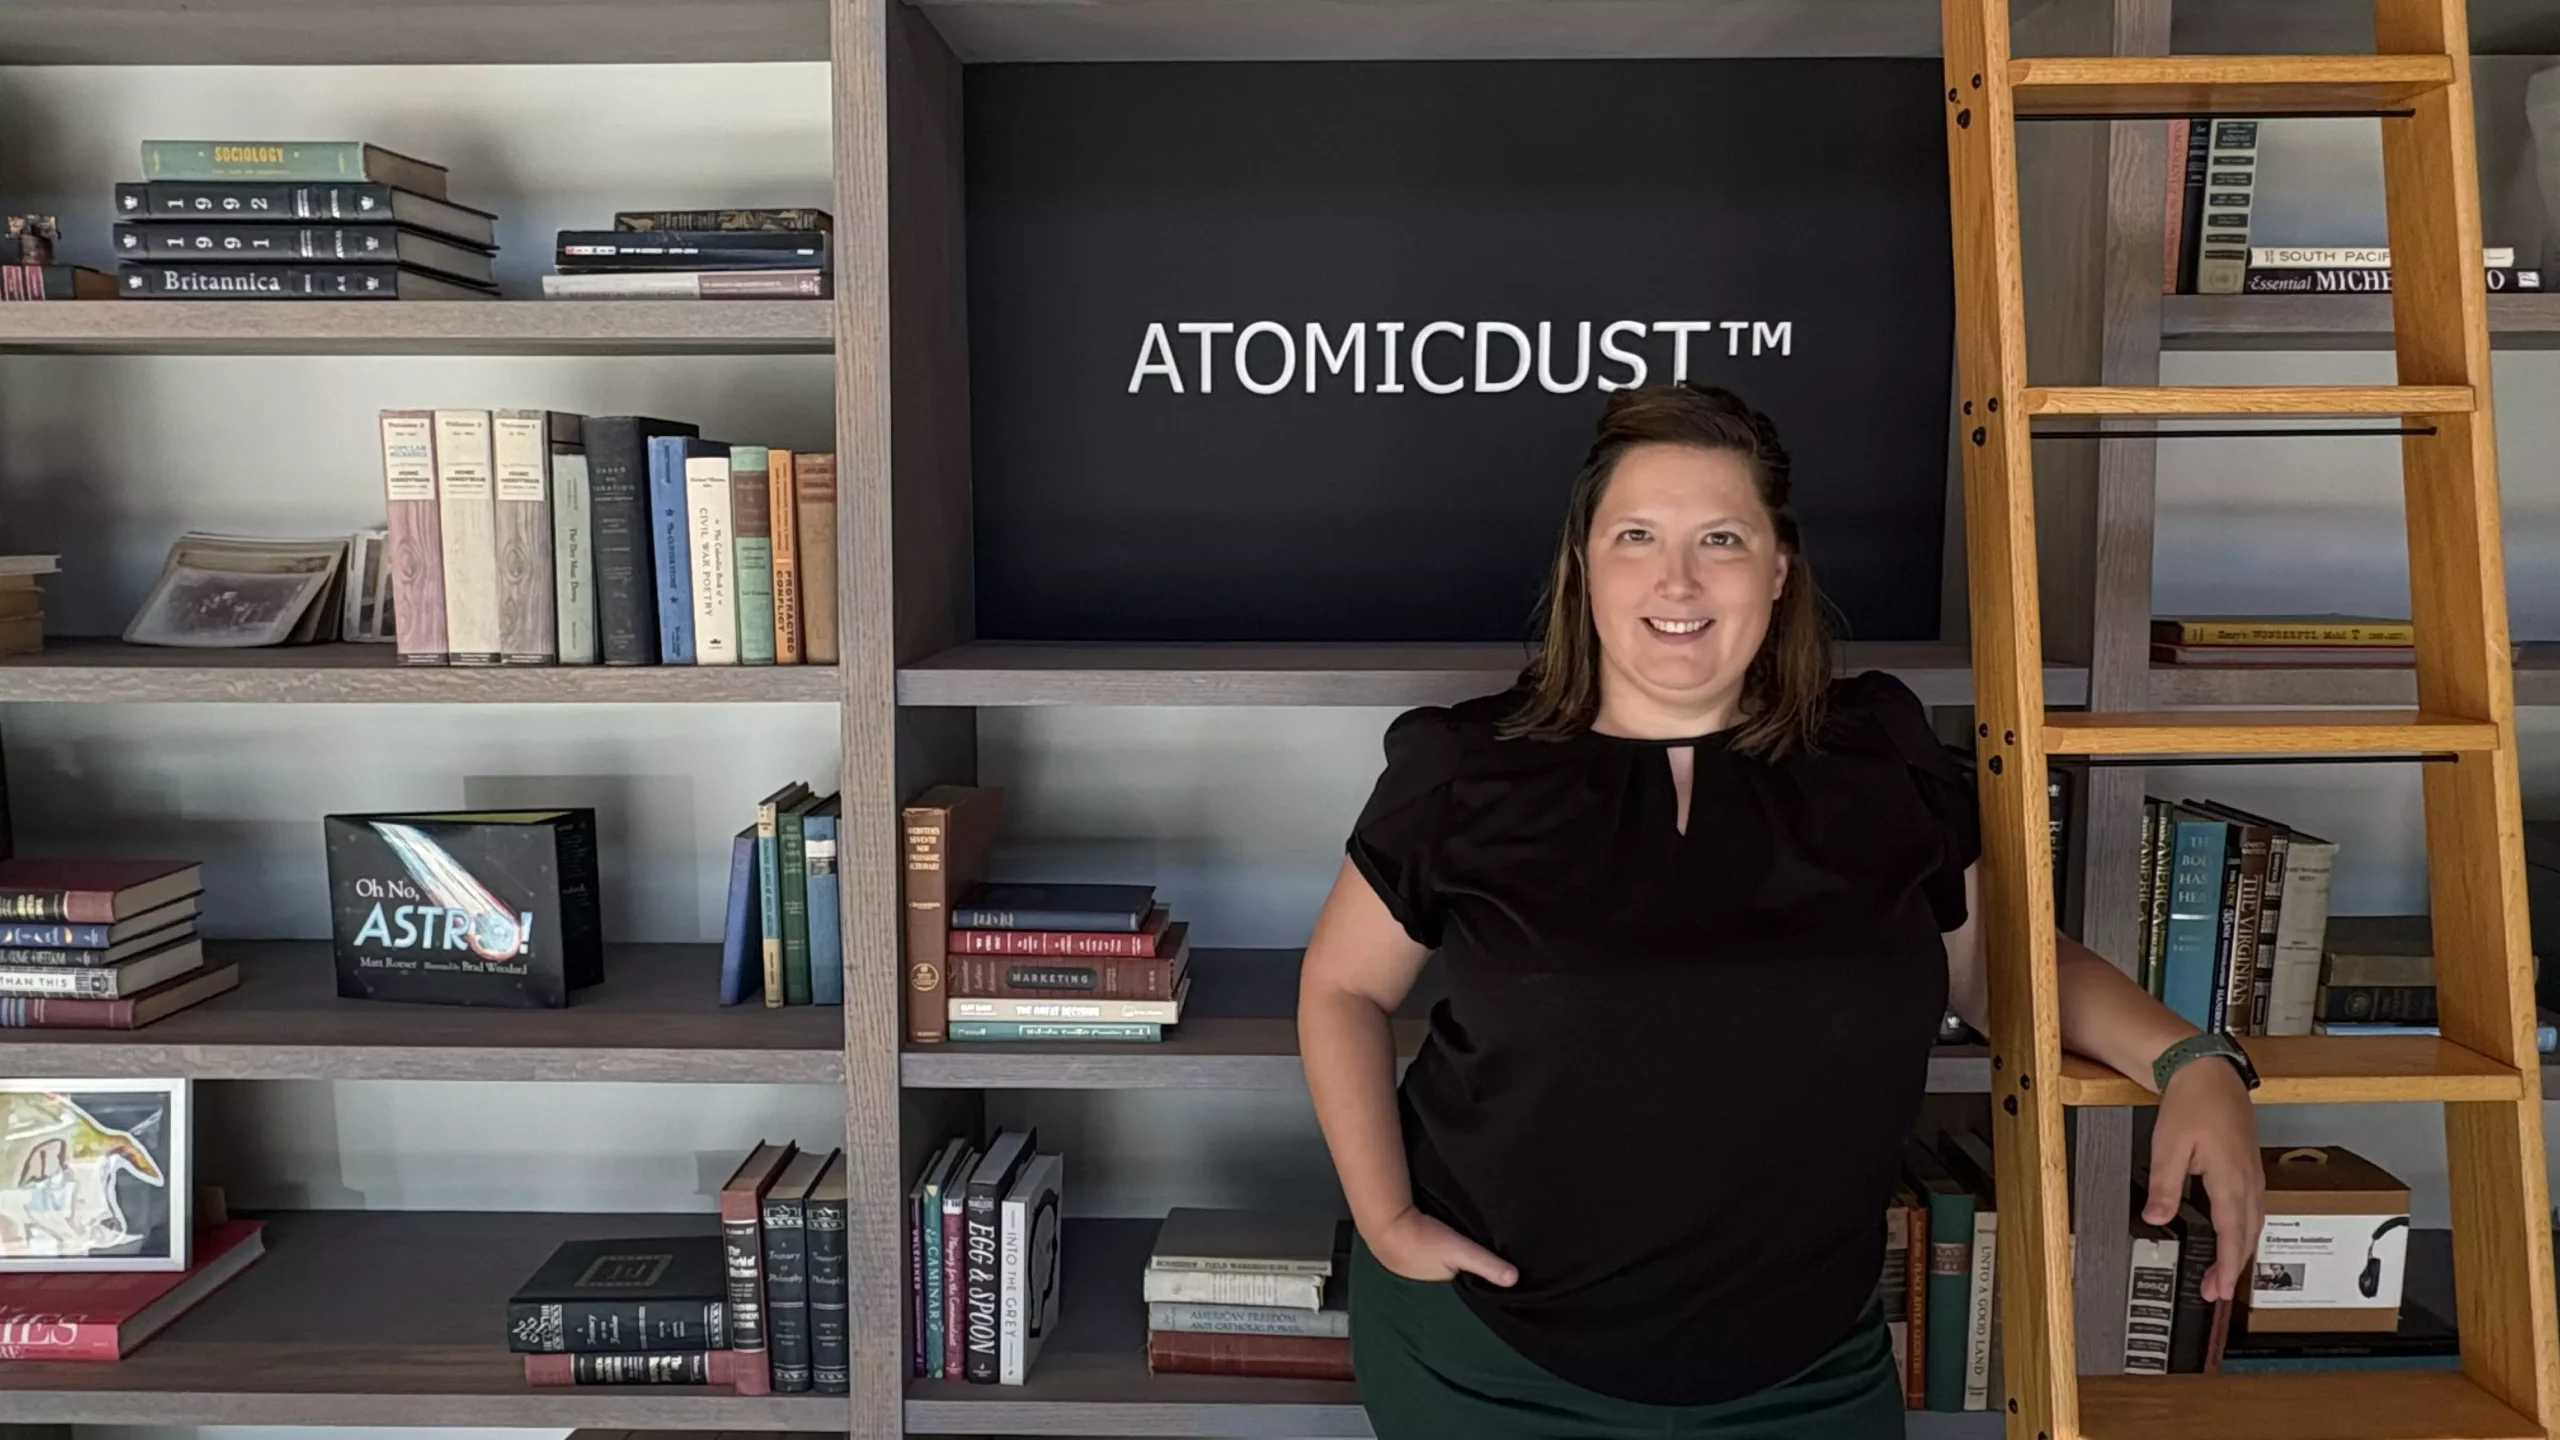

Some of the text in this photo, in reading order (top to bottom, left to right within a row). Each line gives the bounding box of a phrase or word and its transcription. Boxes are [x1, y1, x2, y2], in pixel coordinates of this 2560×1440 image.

[214, 146, 284, 162] SOCIOLOGY
[2279, 251, 2336, 262] SOUTH
[164, 270, 281, 291] Britannica
[2250, 273, 2312, 291] Essential
[698, 507, 713, 617] CIVIL WAR POETRY
[776, 570, 785, 632] CONFLICT
[785, 570, 795, 653] PROTRACTED
[2252, 629, 2319, 640] WONDERFUL
[2351, 629, 2360, 641] T
[916, 844, 930, 853] NEW
[356, 878, 420, 902] Oh No,
[2152, 841, 2170, 925] AMERICA
[2179, 873, 2209, 886] HAS
[2225, 883, 2236, 905] NEW
[2232, 876, 2258, 1005] THE VIRGINIAN
[462, 960, 484, 972] Brad
[0, 977, 68, 988] THAN THIS
[1012, 973, 1090, 984] MARKETING
[1016, 1006, 1033, 1017] THE
[1034, 1006, 1060, 1017] GREAT
[728, 1245, 741, 1257] The
[912, 1229, 921, 1290] UNLEASHED
[767, 1273, 804, 1283] Philosophy
[926, 1246, 942, 1319] CAMINAR
[968, 1220, 996, 1355] EGG & SPOON
[1004, 1232, 1018, 1338] INTO THE GREY
[1190, 1310, 1297, 1322] AMERICAN FREEDOM
[1912, 1295, 1922, 1327] RIVER
[1974, 1245, 1992, 1376] UNTO A GOOD LAND
[1189, 1322, 1305, 1333] AND CATHOLIC POWER
[1912, 1329, 1922, 1374] COUNTRY
